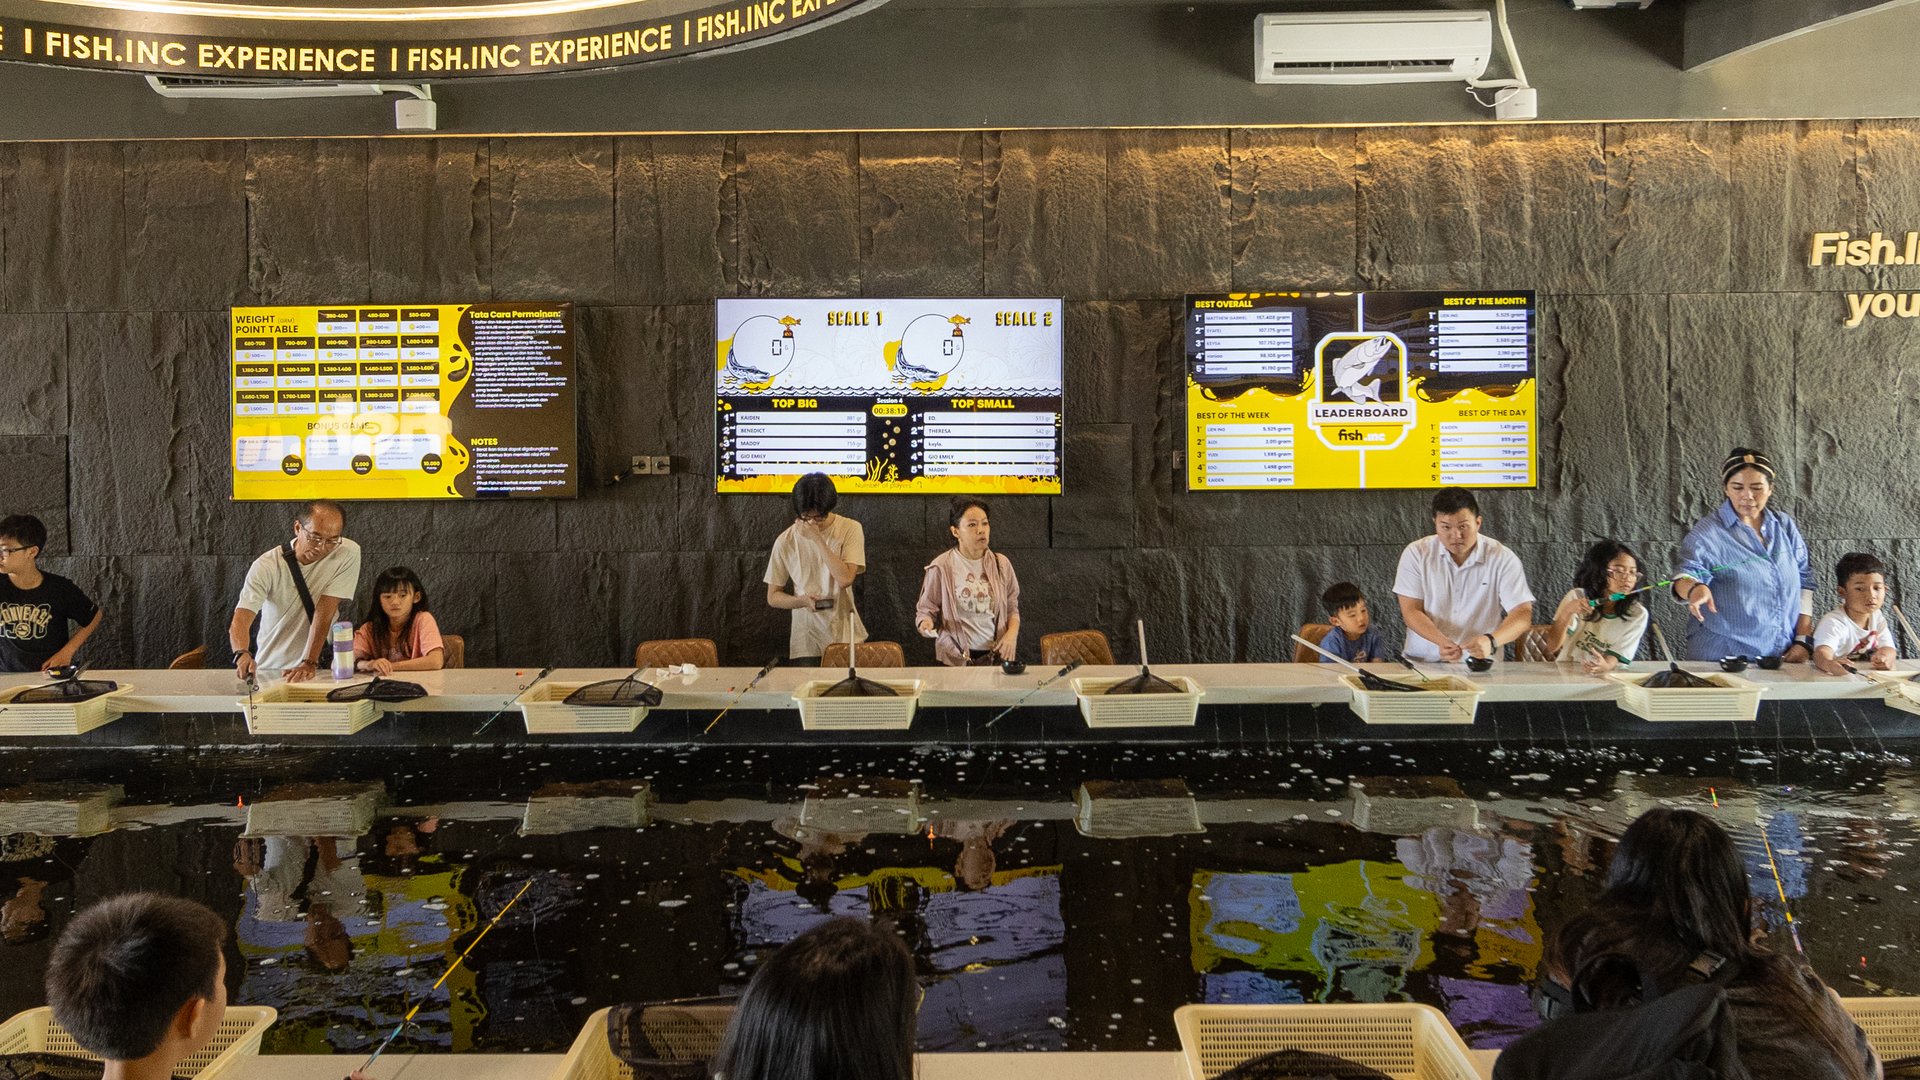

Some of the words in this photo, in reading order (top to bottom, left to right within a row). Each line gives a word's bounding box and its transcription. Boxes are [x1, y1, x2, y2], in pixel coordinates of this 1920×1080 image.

[46, 31, 187, 67] FISH.INC
[198, 44, 375, 72] EXPERIENCE
[408, 43, 520, 71] FISH.INC
[530, 28, 671, 67] EXPERIENCE
[697, 0, 785, 43] FISH.INC
[1811, 231, 1920, 266] Fish.I
[1195, 300, 1214, 308] BEST
[1216, 300, 1253, 308] OVERALL
[513, 310, 561, 318] Permainan:
[828, 311, 869, 326] SCALE
[876, 310, 882, 326] 1
[996, 311, 1037, 326] SCALE
[1044, 311, 1052, 326] 2
[269, 325, 298, 333] TABLE
[772, 399, 796, 408] TOP
[798, 399, 817, 408] BIG
[951, 399, 974, 409] TOP
[977, 399, 1015, 409] SMALL
[1315, 409, 1408, 417] LEADERBOARD
[307, 422, 339, 430] BONUS
